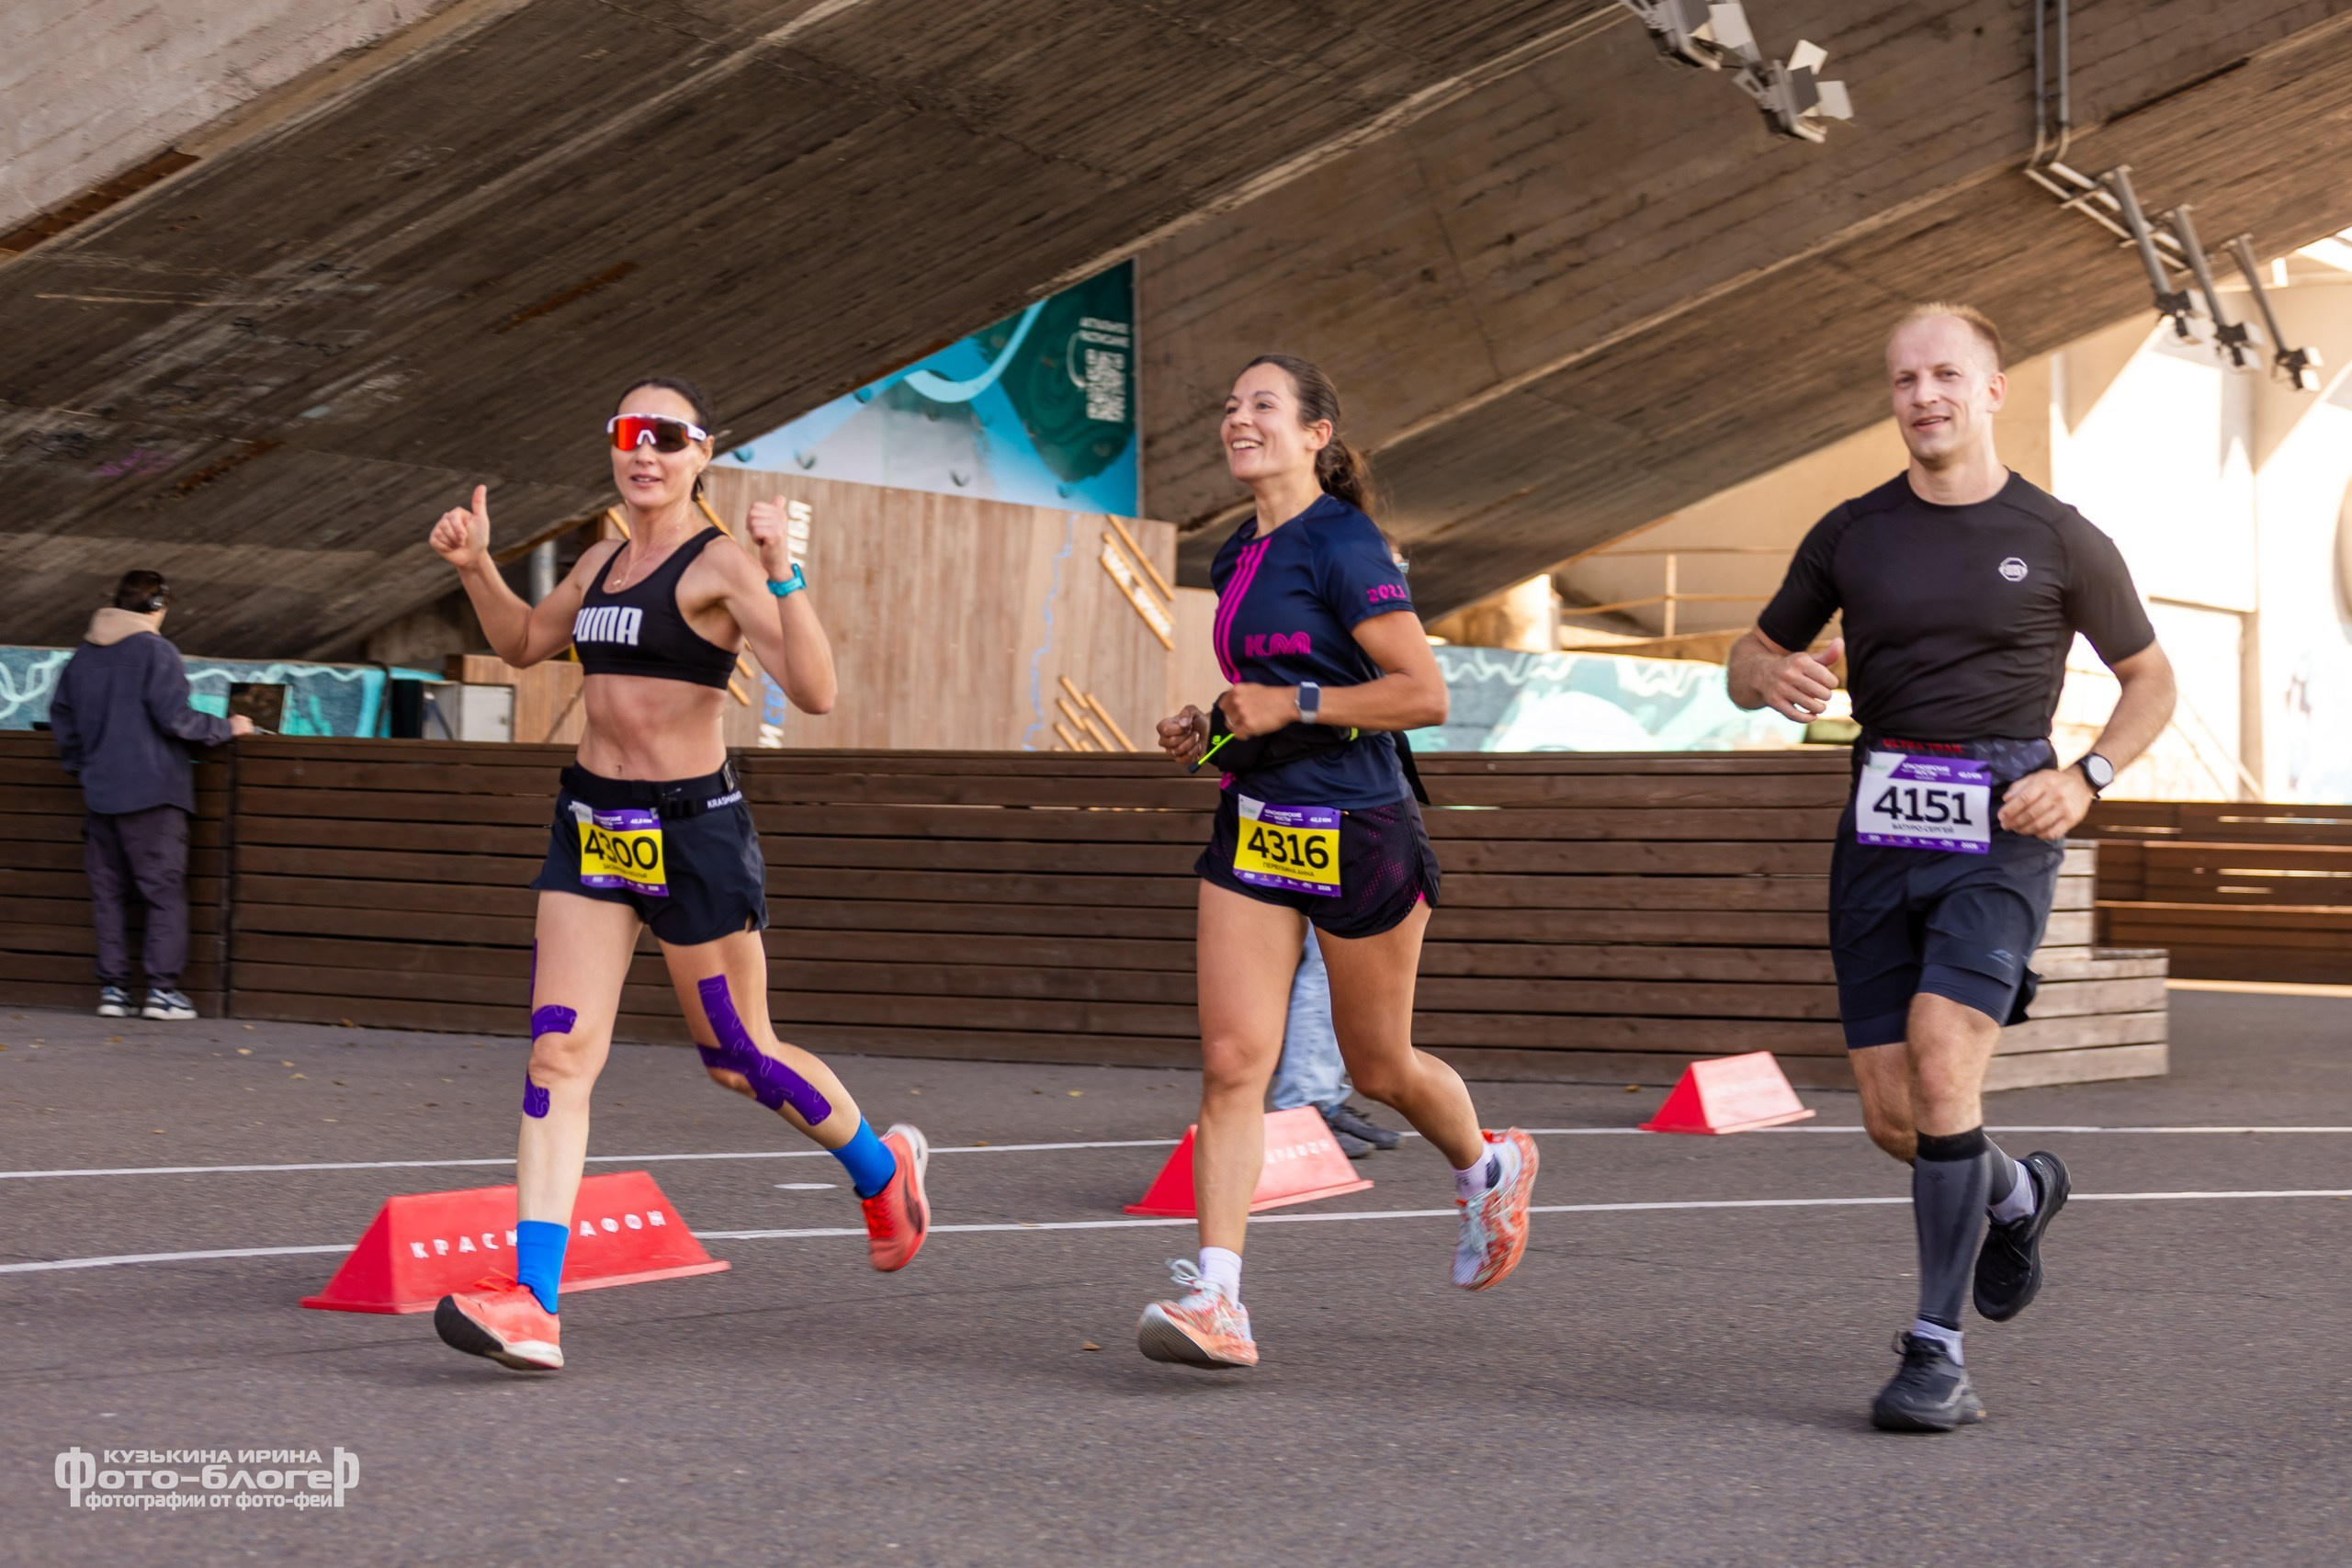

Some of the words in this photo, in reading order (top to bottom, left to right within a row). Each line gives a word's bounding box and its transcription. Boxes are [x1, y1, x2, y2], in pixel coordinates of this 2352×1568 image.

[1367, 584, 1407, 603] 2021
[1872, 786, 1973, 826] 4151
[584, 829, 659, 870] 4300
[1248, 827, 1329, 869] 4316
